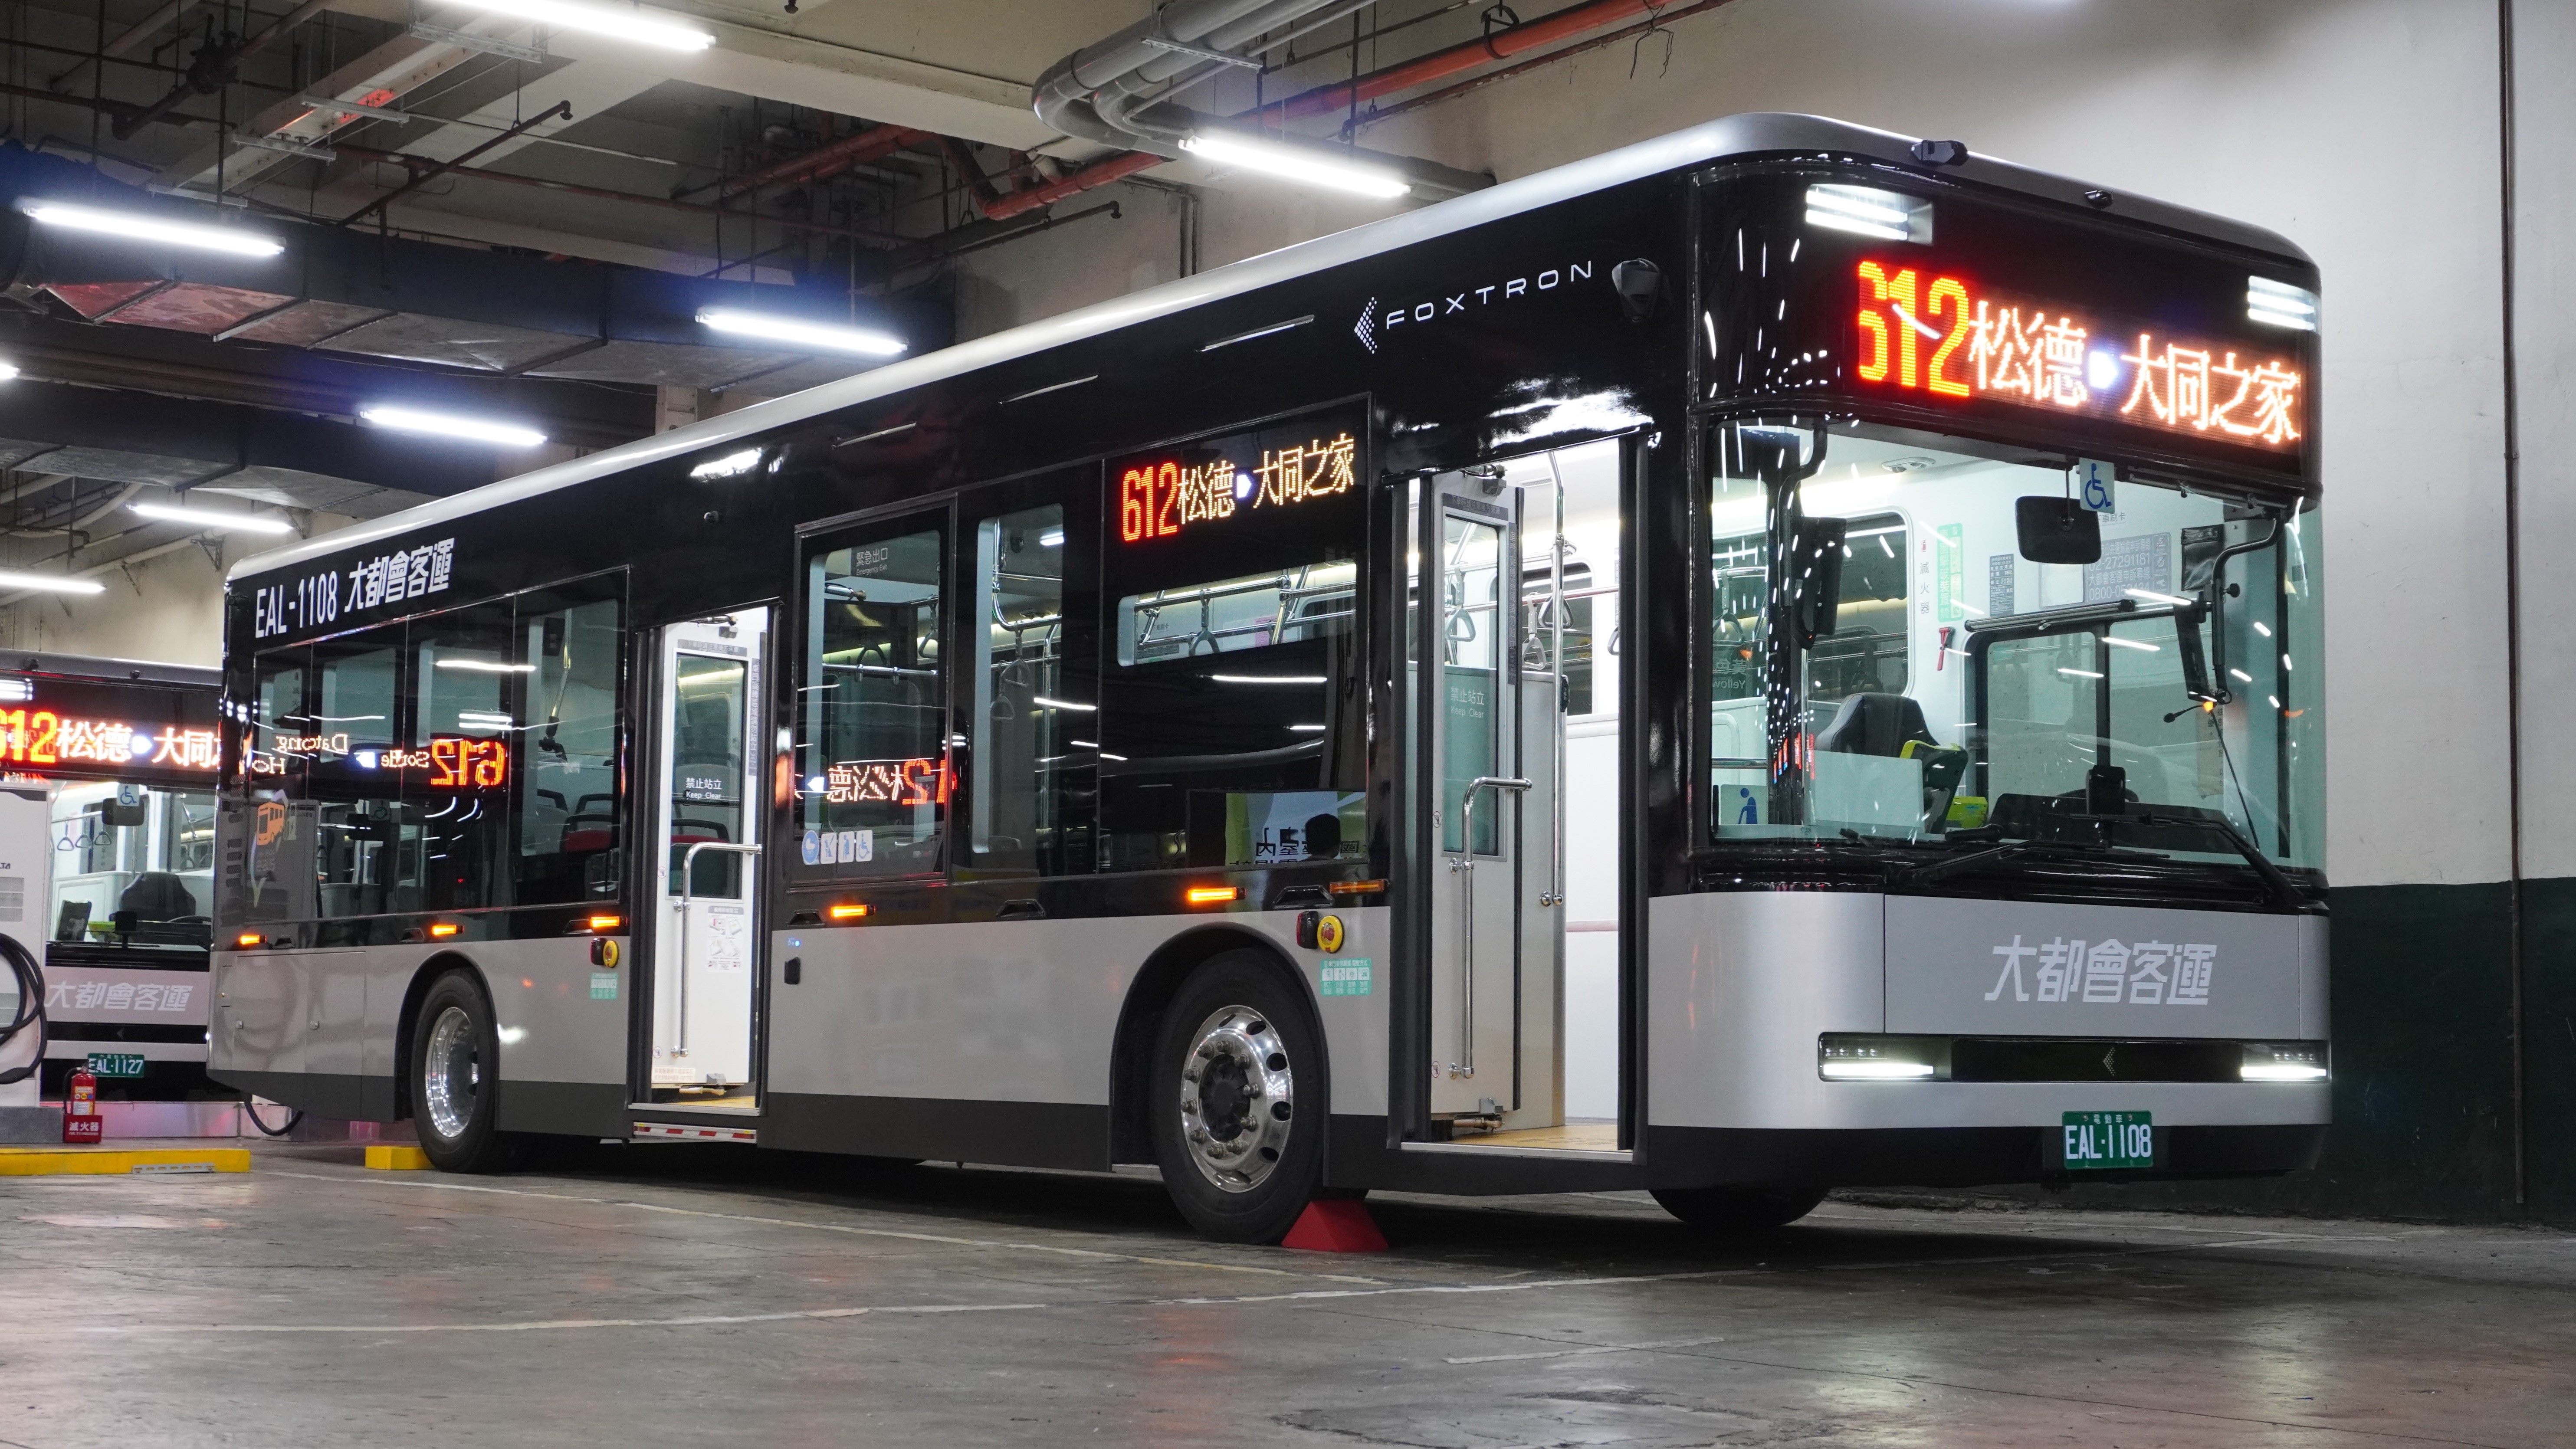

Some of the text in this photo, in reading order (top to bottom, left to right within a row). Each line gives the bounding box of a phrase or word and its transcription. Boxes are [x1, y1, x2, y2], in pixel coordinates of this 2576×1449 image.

[1387, 260, 1591, 329] FOXTRON
[1859, 261, 2301, 443] 612 松德 大同之家
[1123, 433, 1354, 541] 612 松德 大同之家
[856, 547, 888, 567] 緊急出口
[256, 538, 455, 638] EAL-1108 大都會客運
[1920, 563, 1930, 614] 滅火器
[1450, 686, 1484, 705] 禁止站立
[1469, 708, 1484, 718] Clear
[57, 720, 132, 762] 松德
[152, 728, 220, 767] 大同
[686, 777, 722, 790] 禁止站立
[686, 791, 702, 800] Keep
[1984, 934, 2218, 1005] 大都會客運
[44, 980, 194, 1012] 大都會客運
